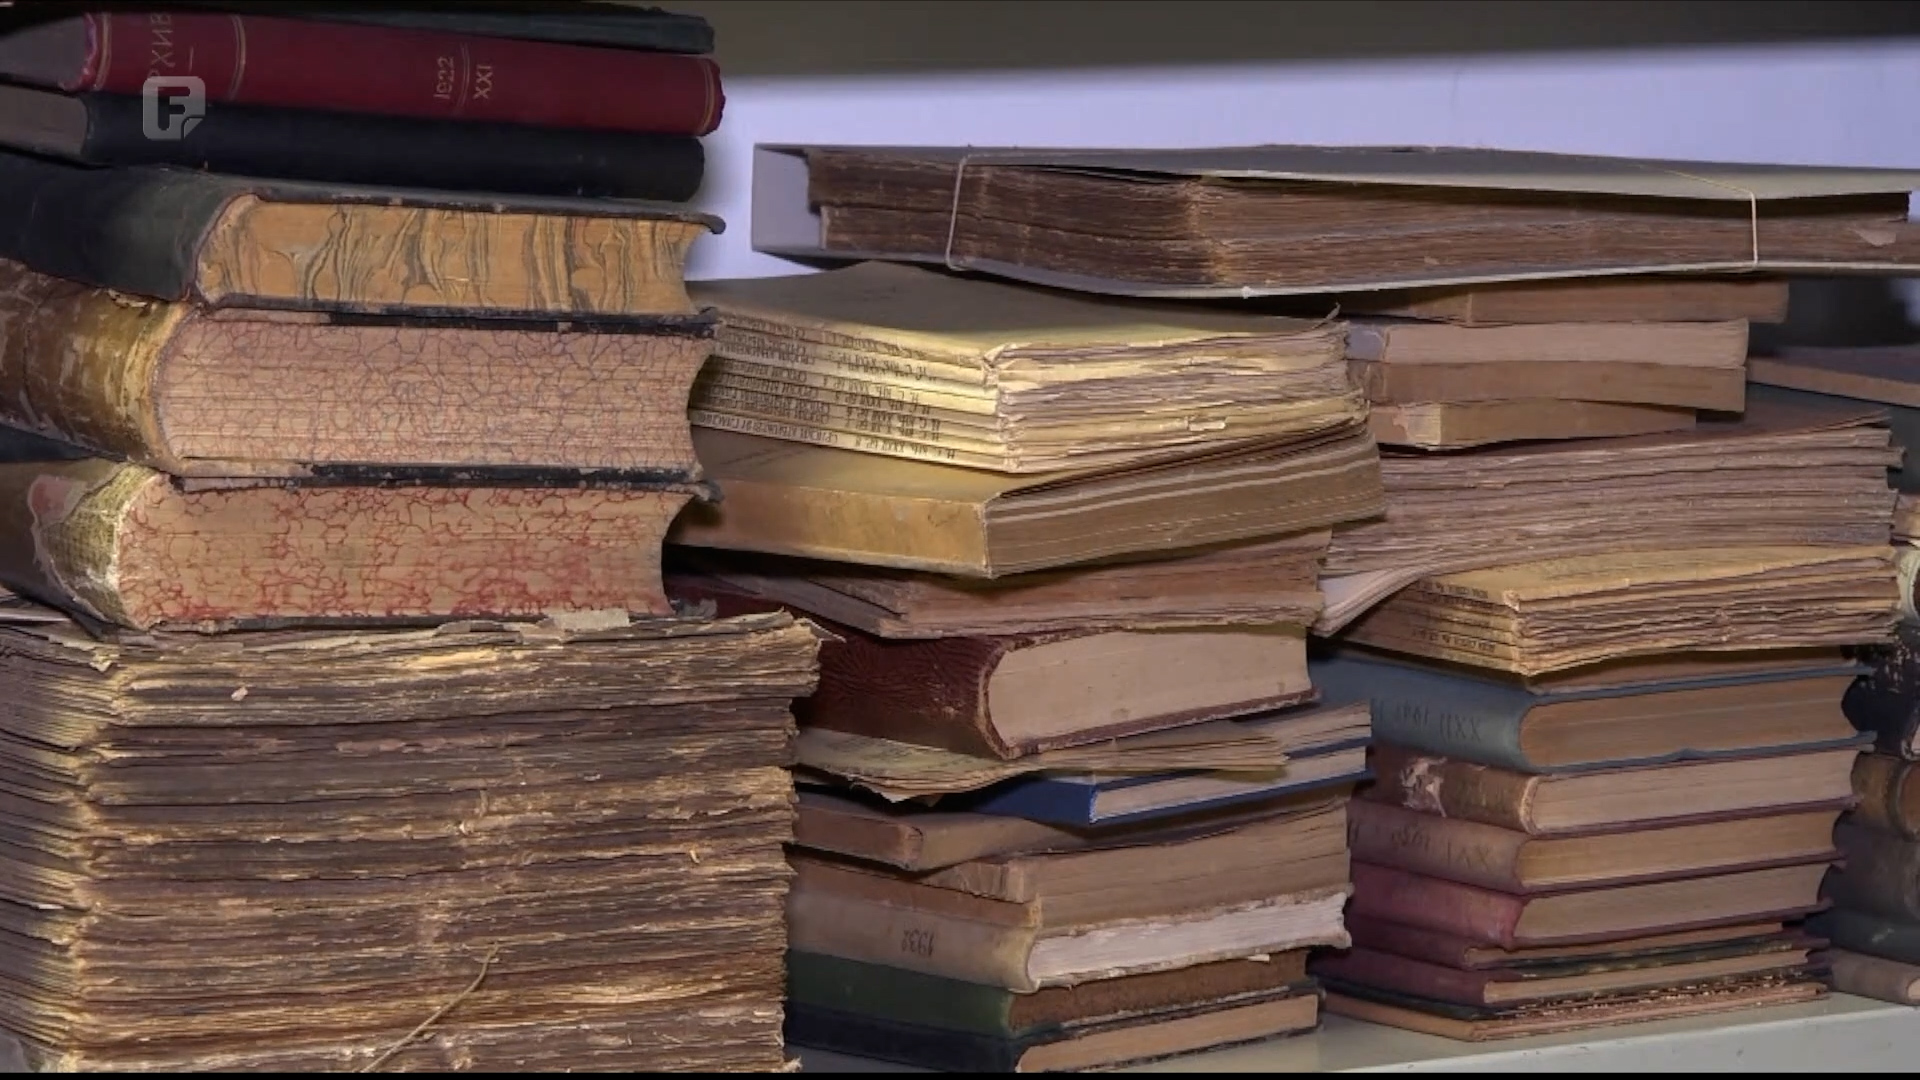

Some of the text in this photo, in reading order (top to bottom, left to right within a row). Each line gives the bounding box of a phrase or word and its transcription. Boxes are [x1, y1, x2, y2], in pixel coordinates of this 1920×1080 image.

[147, 13, 176, 89] РХИВ
[433, 55, 455, 100] 1922
[473, 64, 493, 100] XXI
